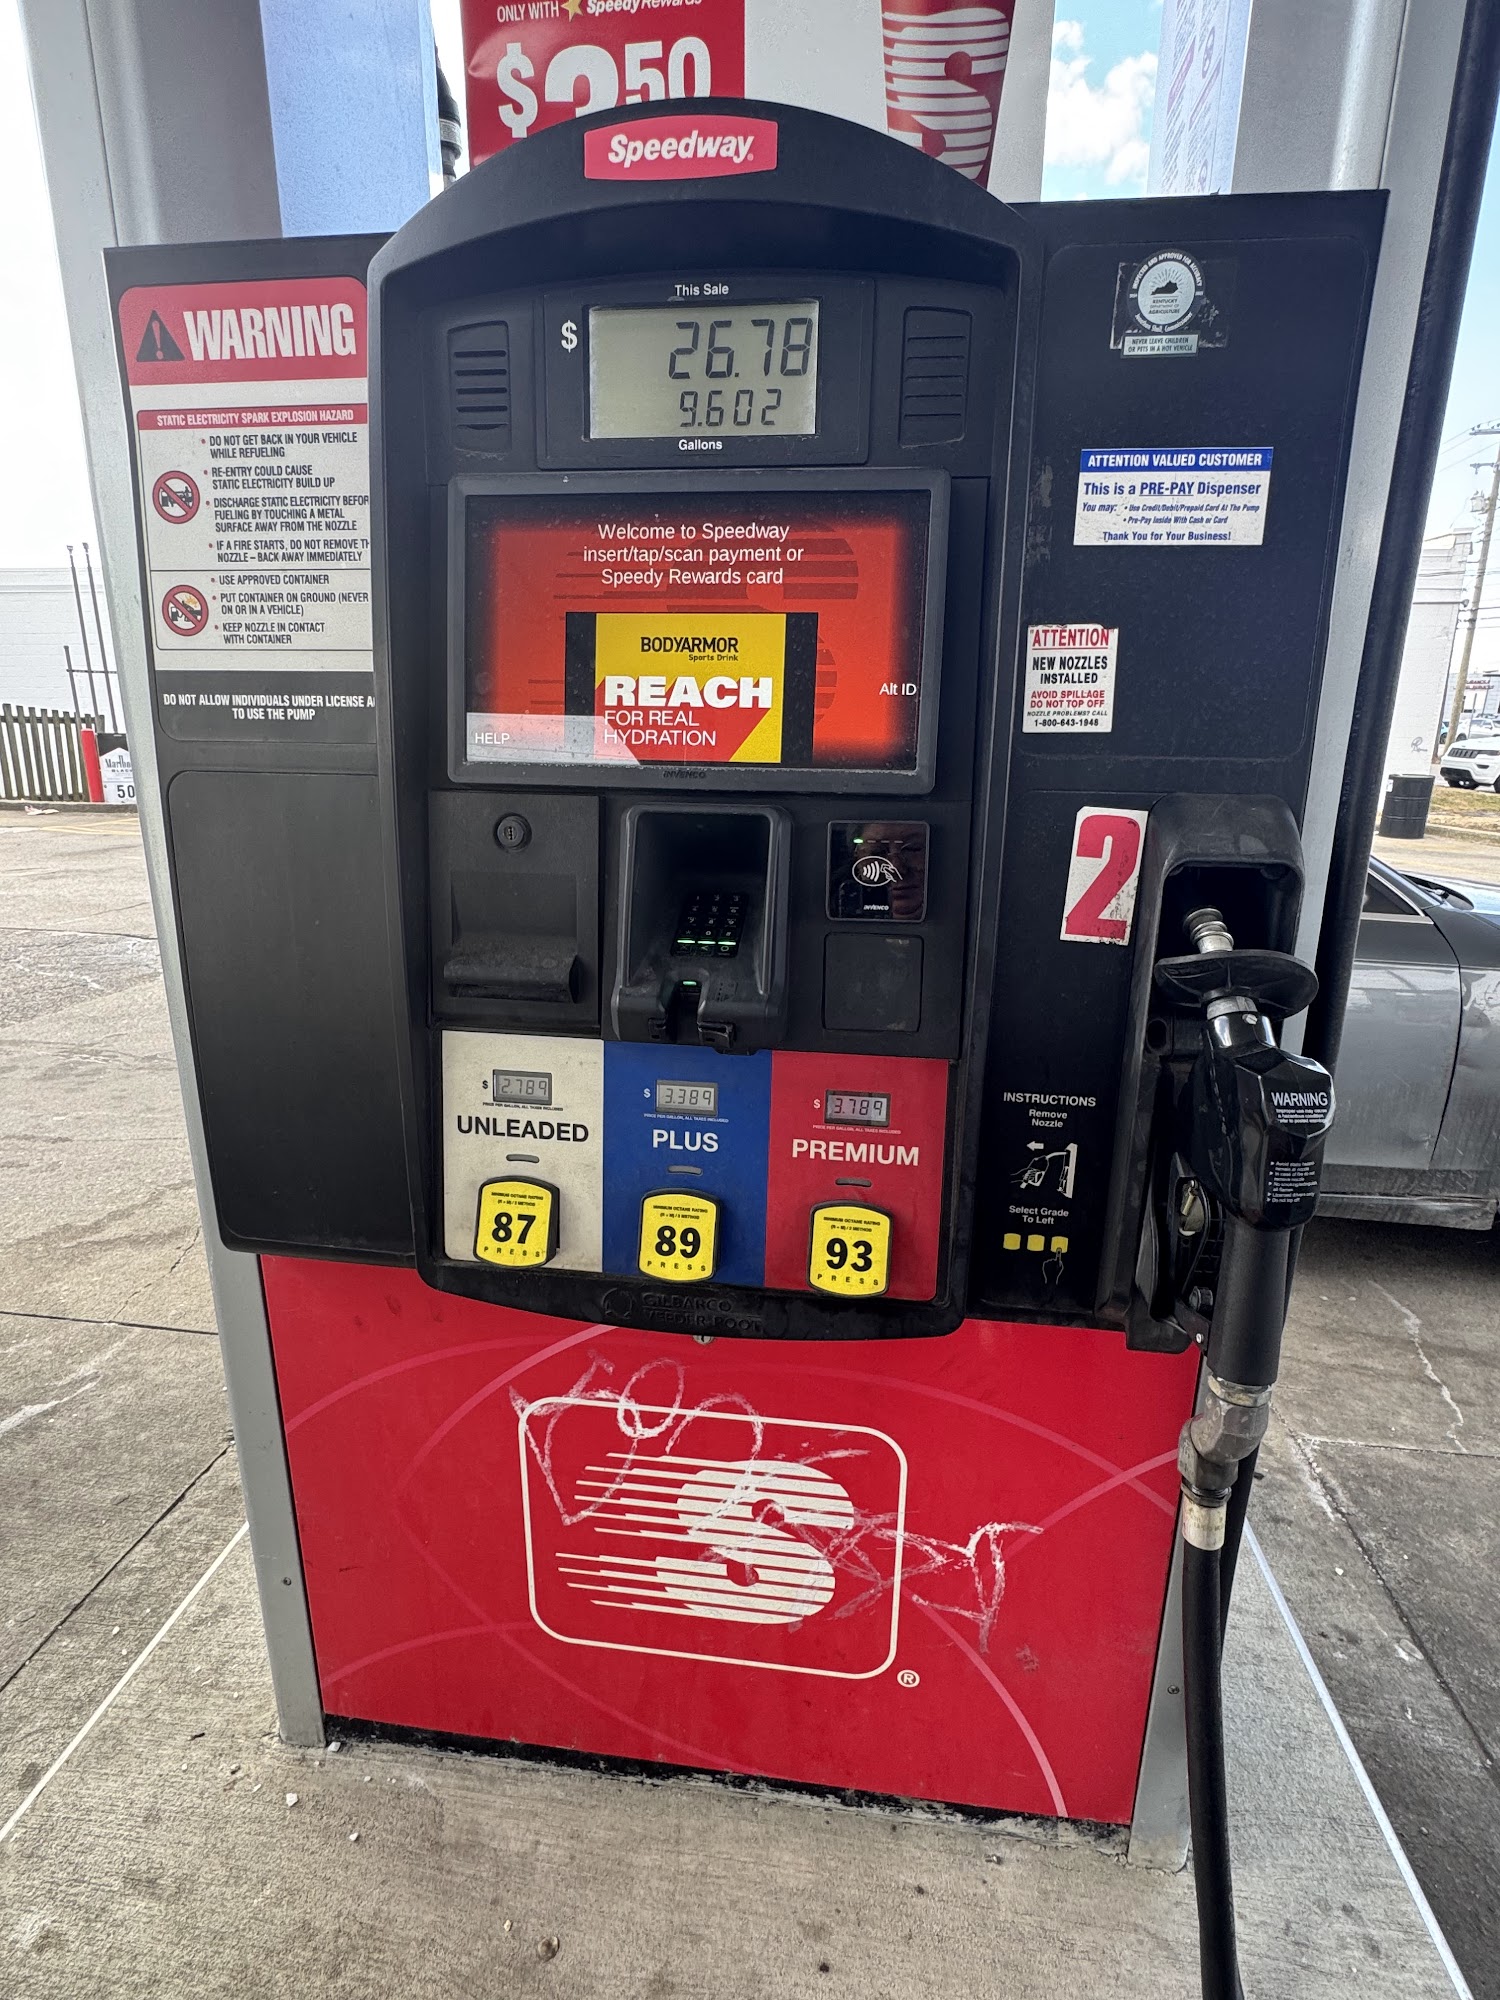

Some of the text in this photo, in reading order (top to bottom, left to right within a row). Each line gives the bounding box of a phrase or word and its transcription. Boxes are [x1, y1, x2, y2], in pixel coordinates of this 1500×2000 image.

[497, 4, 525, 23] ONLY
[528, 1, 560, 20] WITH
[674, 283, 730, 297] This Sale
[183, 303, 356, 362] WARNING
[561, 317, 814, 380] $ 26.78
[679, 388, 782, 428] 9.602
[157, 409, 354, 426] STATIC ELECTRICITY SPARK EXPLOSION HAZARD
[209, 432, 358, 446] DO NOT GET BACK IN YOUR VEHICLE
[678, 439, 724, 451] Gallons
[210, 447, 286, 460] WHILE REFUELING
[1088, 453, 1262, 468] ATTENTION VALUED CUSTOMER
[212, 465, 313, 478] RE-ENTRY COULD CAUSE
[212, 477, 336, 490] STATIC ELECTRICITY BUILD UP
[1083, 482, 1262, 498] This is a PRE-PAY Dispenser
[214, 497, 260, 508] DISCHARGE
[261, 496, 288, 508] STATIC
[290, 496, 342, 506] ELECTRICITY
[1082, 503, 1118, 513] You may:
[1129, 504, 1260, 514] Use Credit/Debit/Prepaid Card At The Pump
[1127, 516, 1152, 526] Pre-Pay
[1153, 516, 1172, 524] Inside
[1173, 516, 1188, 524] With
[1189, 516, 1204, 524] Cash
[1213, 516, 1228, 524] Card
[598, 522, 790, 543] Welcome to Speedway
[1103, 531, 1232, 541] Thank You for Your Business!
[583, 545, 804, 566] insert/tap/scan payment or
[601, 567, 784, 588] Speedy Rewards card
[220, 592, 369, 604] PUT CONTAINER ON GROUND (NEVER
[222, 622, 326, 632] KEEP NOZZLE IN CONTACT
[640, 637, 739, 654] BODYARMOR
[688, 654, 739, 663] Sports Drink
[1032, 656, 1108, 670] NEW NOZZLES
[1040, 673, 1098, 684] INSTALLED
[604, 675, 773, 709] REACH
[879, 683, 918, 696] Alt ID
[1031, 690, 1106, 699] AVOID SPILLAGE
[163, 694, 376, 708] DO NOT ALLOW INDIVIDUALS UNDER LICENSE A
[1030, 700, 1105, 708] DO NOT TOP OFF
[232, 708, 316, 721] TO USE THE PUMP
[604, 710, 700, 727] FOR REAL
[474, 732, 510, 745] HELP
[603, 729, 716, 746] HYDRATION
[117, 785, 136, 799] 50
[1065, 814, 1141, 940] 2
[482, 1078, 548, 1096] $ 2.789
[643, 1088, 712, 1106] $ 3.389
[1003, 1092, 1097, 1108] INSTRUCTIONS
[1271, 1092, 1328, 1107] WARNING
[813, 1098, 884, 1116] $ 3.789
[1029, 1109, 1068, 1119] Remove
[457, 1115, 590, 1143] UNLEADED
[1031, 1118, 1064, 1128] Nozzle
[652, 1128, 720, 1153] PLUS
[791, 1138, 920, 1167] PREMIUM
[1009, 1205, 1070, 1218] Select Grade
[1022, 1215, 1055, 1225] To Left
[491, 1212, 536, 1244] 87
[654, 1225, 701, 1259] 89
[826, 1237, 874, 1273] 93
